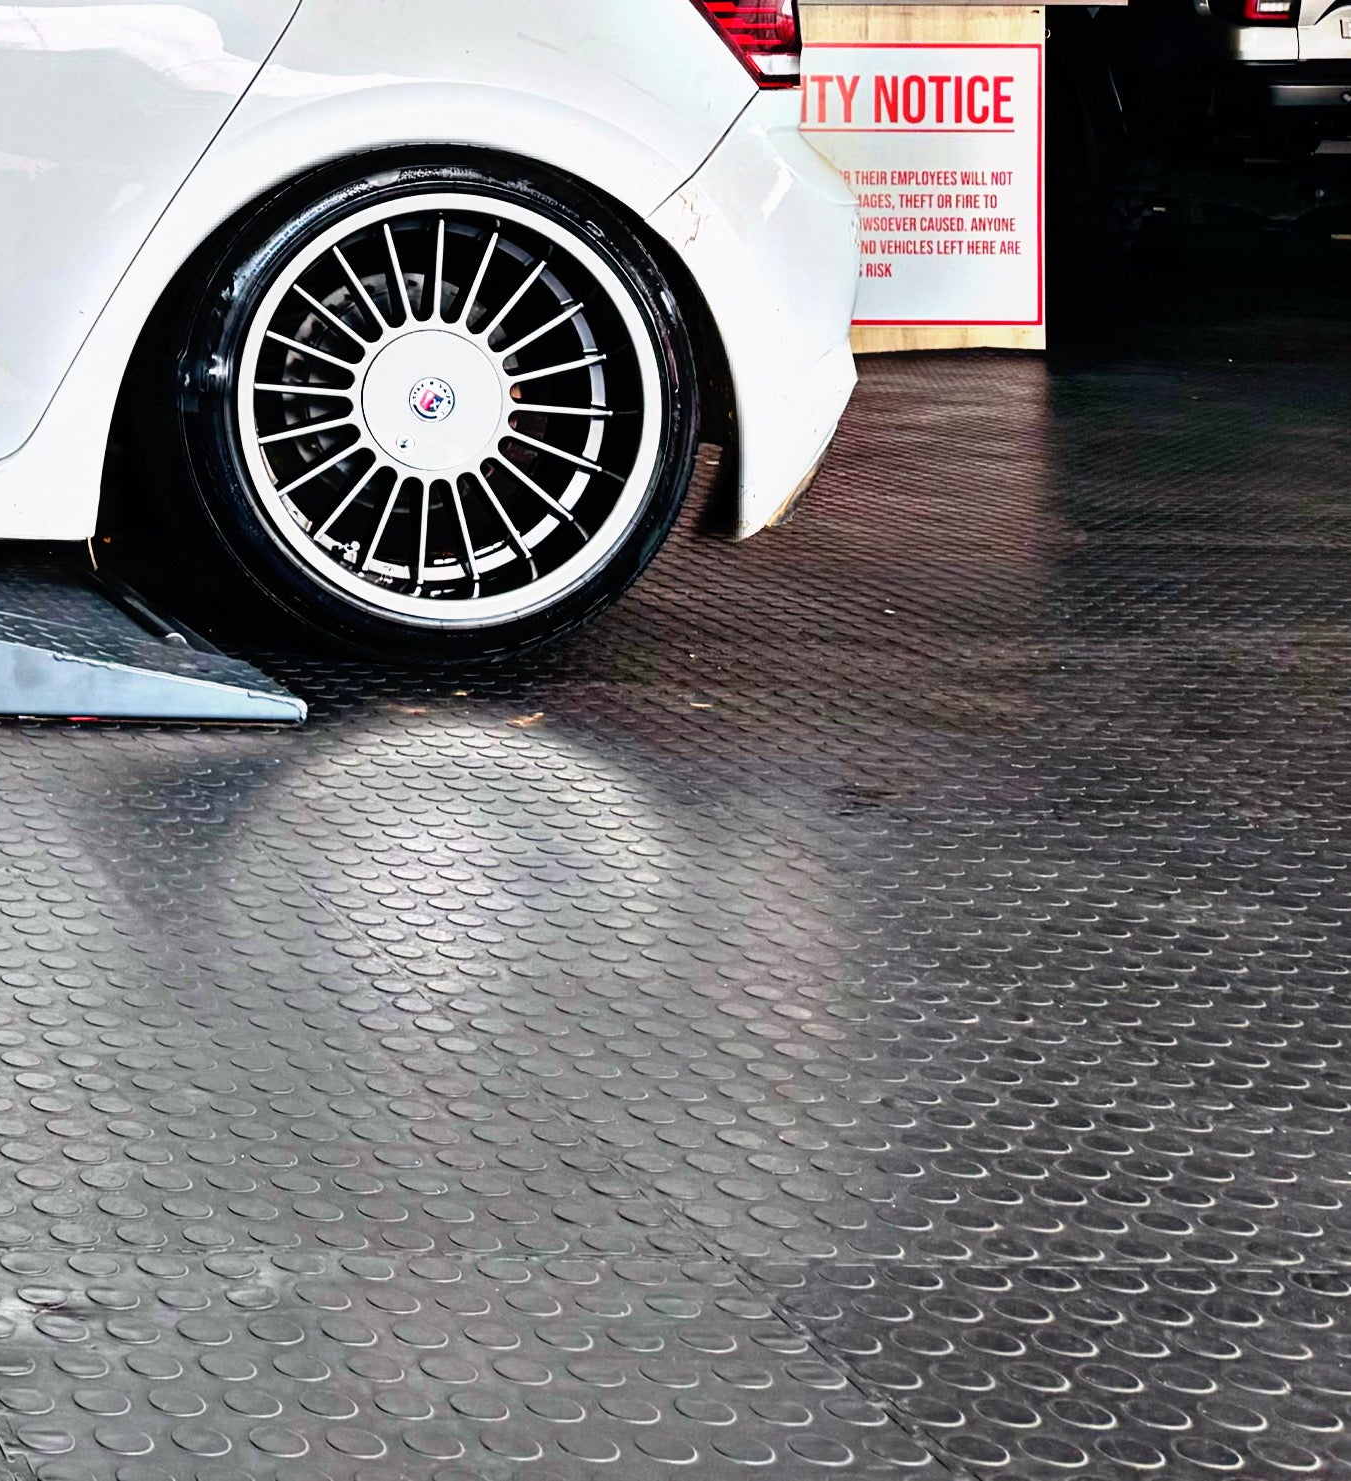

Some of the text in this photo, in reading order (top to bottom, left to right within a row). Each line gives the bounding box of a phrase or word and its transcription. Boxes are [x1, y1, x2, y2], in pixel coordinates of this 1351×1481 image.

[873, 74, 1015, 125] NOTICE
[839, 170, 1014, 186] R THEIR EMPLOYEES WILL NOT
[898, 193, 934, 209] THEFT
[937, 193, 953, 209] OR
[955, 193, 981, 209] FIRE
[983, 193, 998, 209] TO
[919, 216, 968, 232] CAUSED.
[970, 216, 1016, 232] ANYONE
[879, 239, 934, 255] VEHICLES
[936, 239, 964, 255] LEFT
[966, 239, 997, 255] HERE
[999, 239, 1022, 255] ARE
[865, 262, 893, 278] RISK
